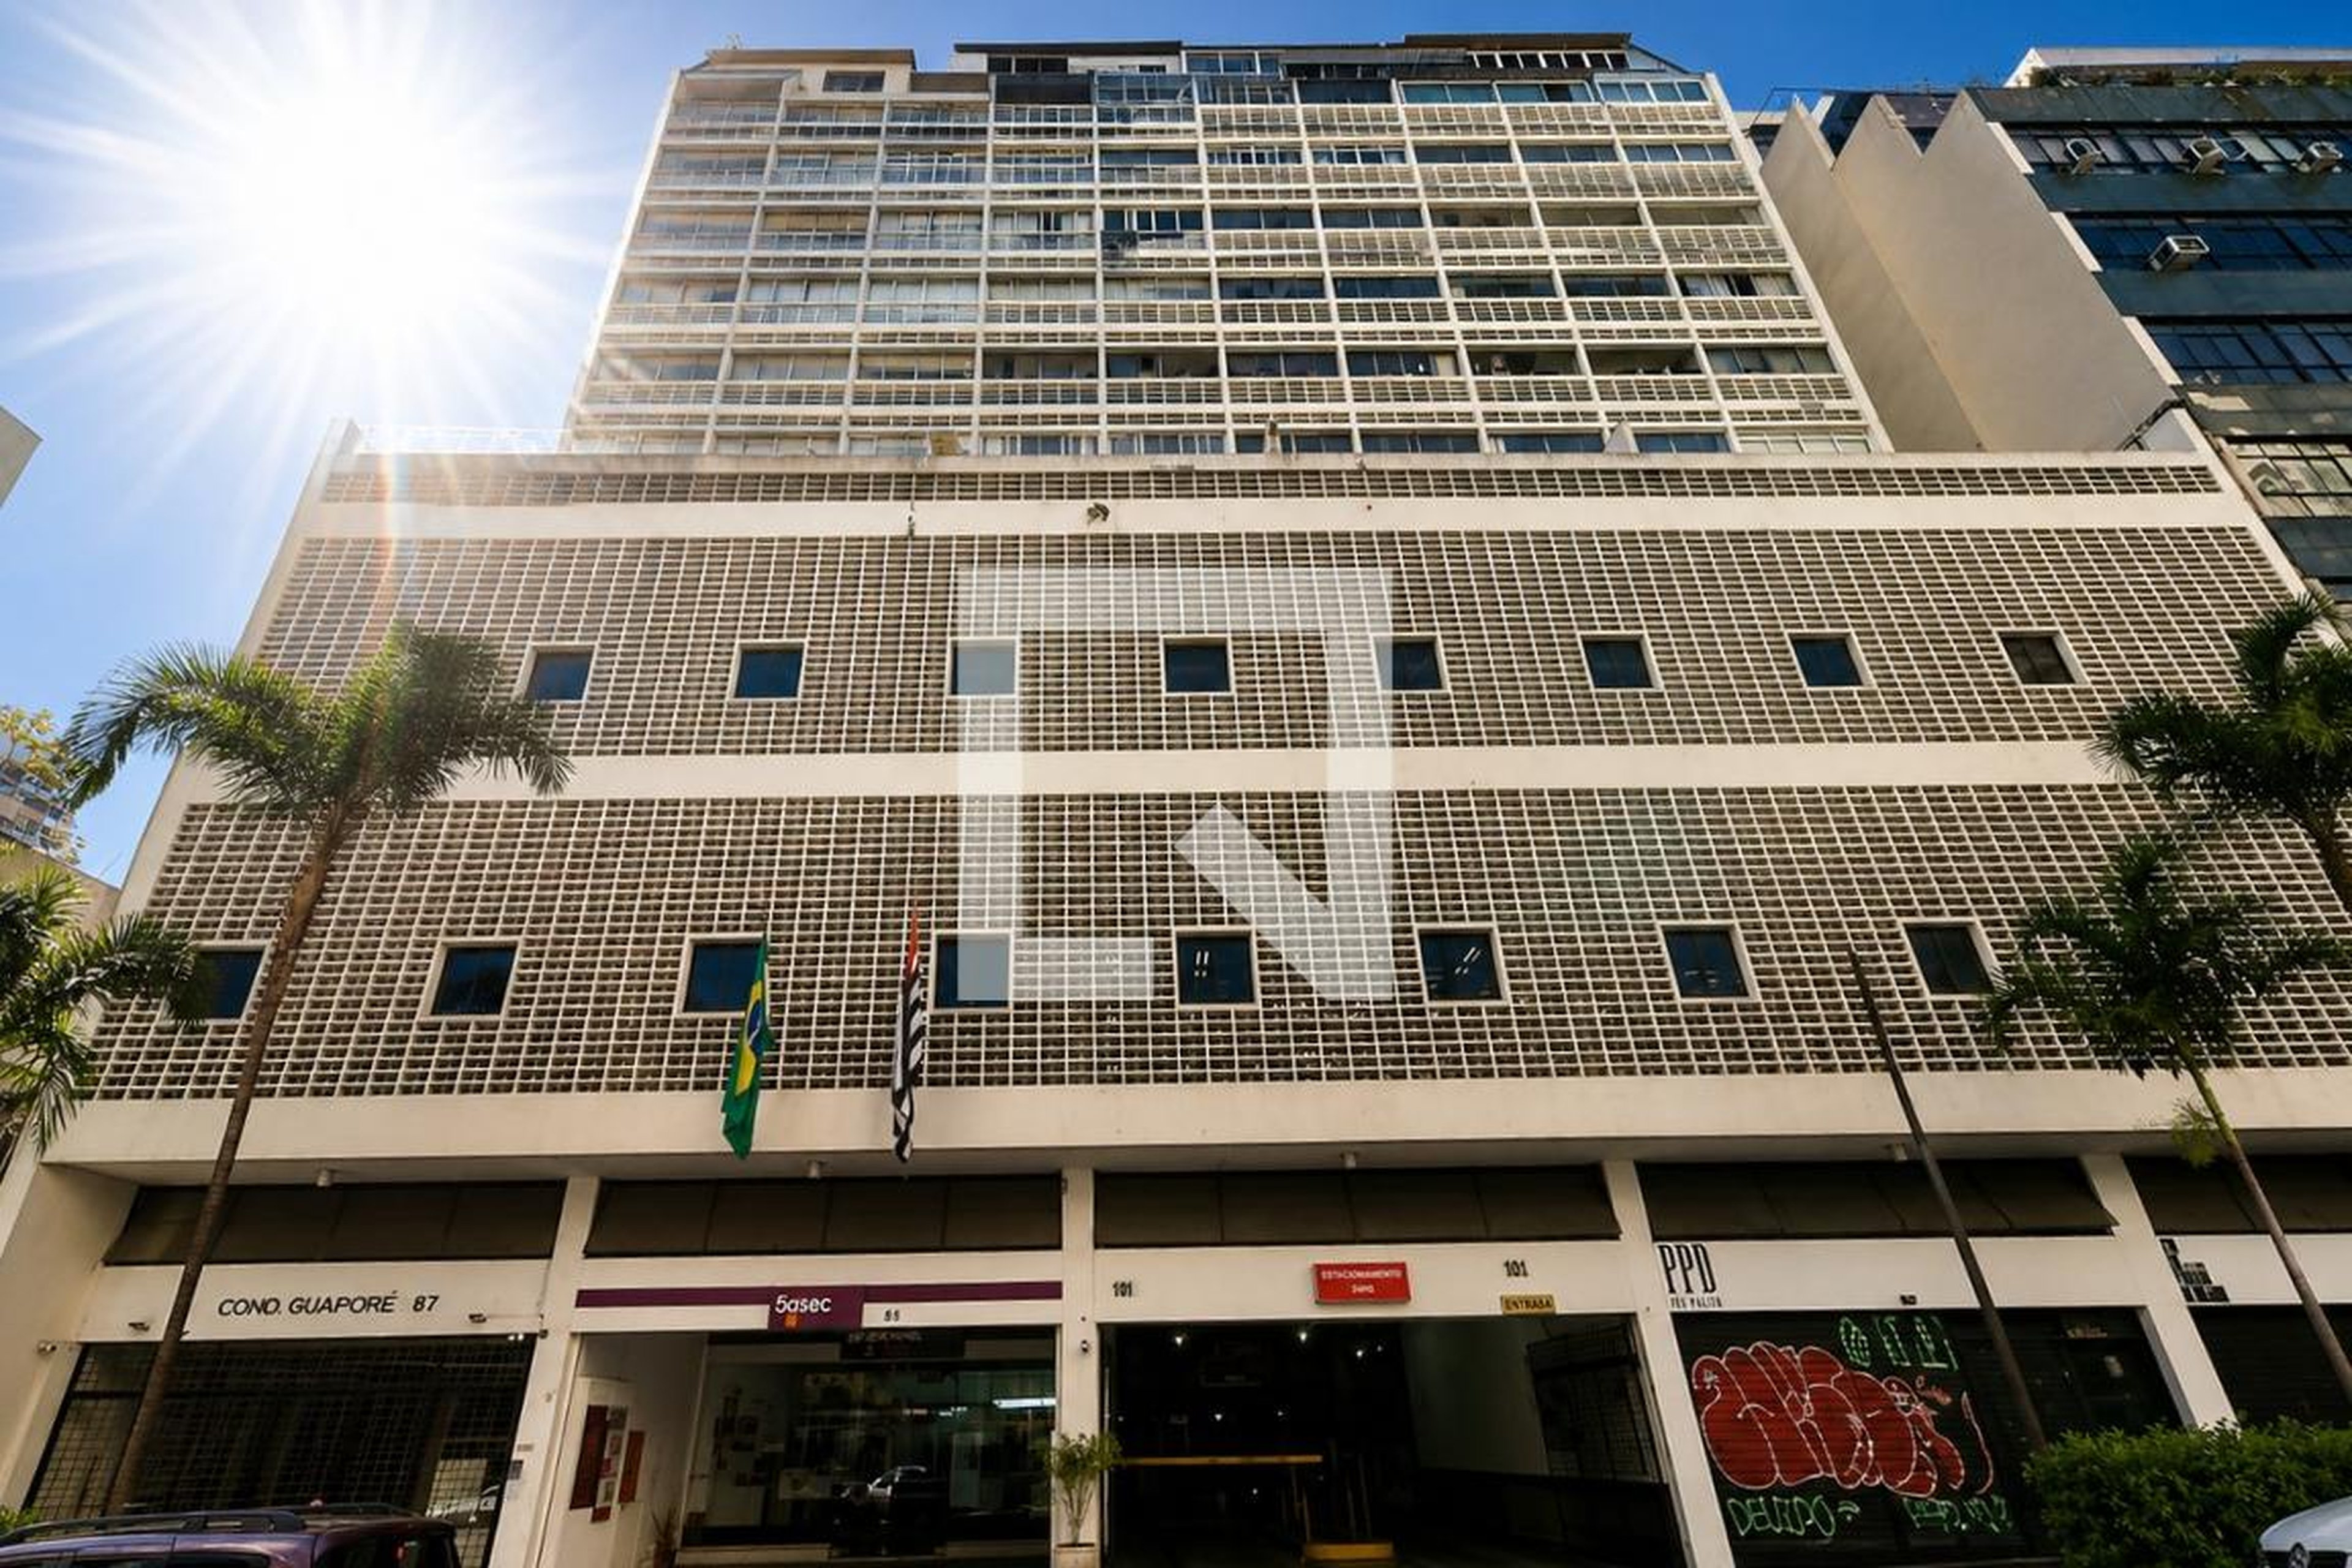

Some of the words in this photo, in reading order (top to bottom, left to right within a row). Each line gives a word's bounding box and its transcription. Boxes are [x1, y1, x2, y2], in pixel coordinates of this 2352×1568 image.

[1504, 1260, 1528, 1277] 101
[1657, 1244, 1716, 1294] PPD
[1112, 1281, 1133, 1297] 101
[288, 1290, 399, 1315] GUAPORÉ
[413, 1295, 440, 1312] 87
